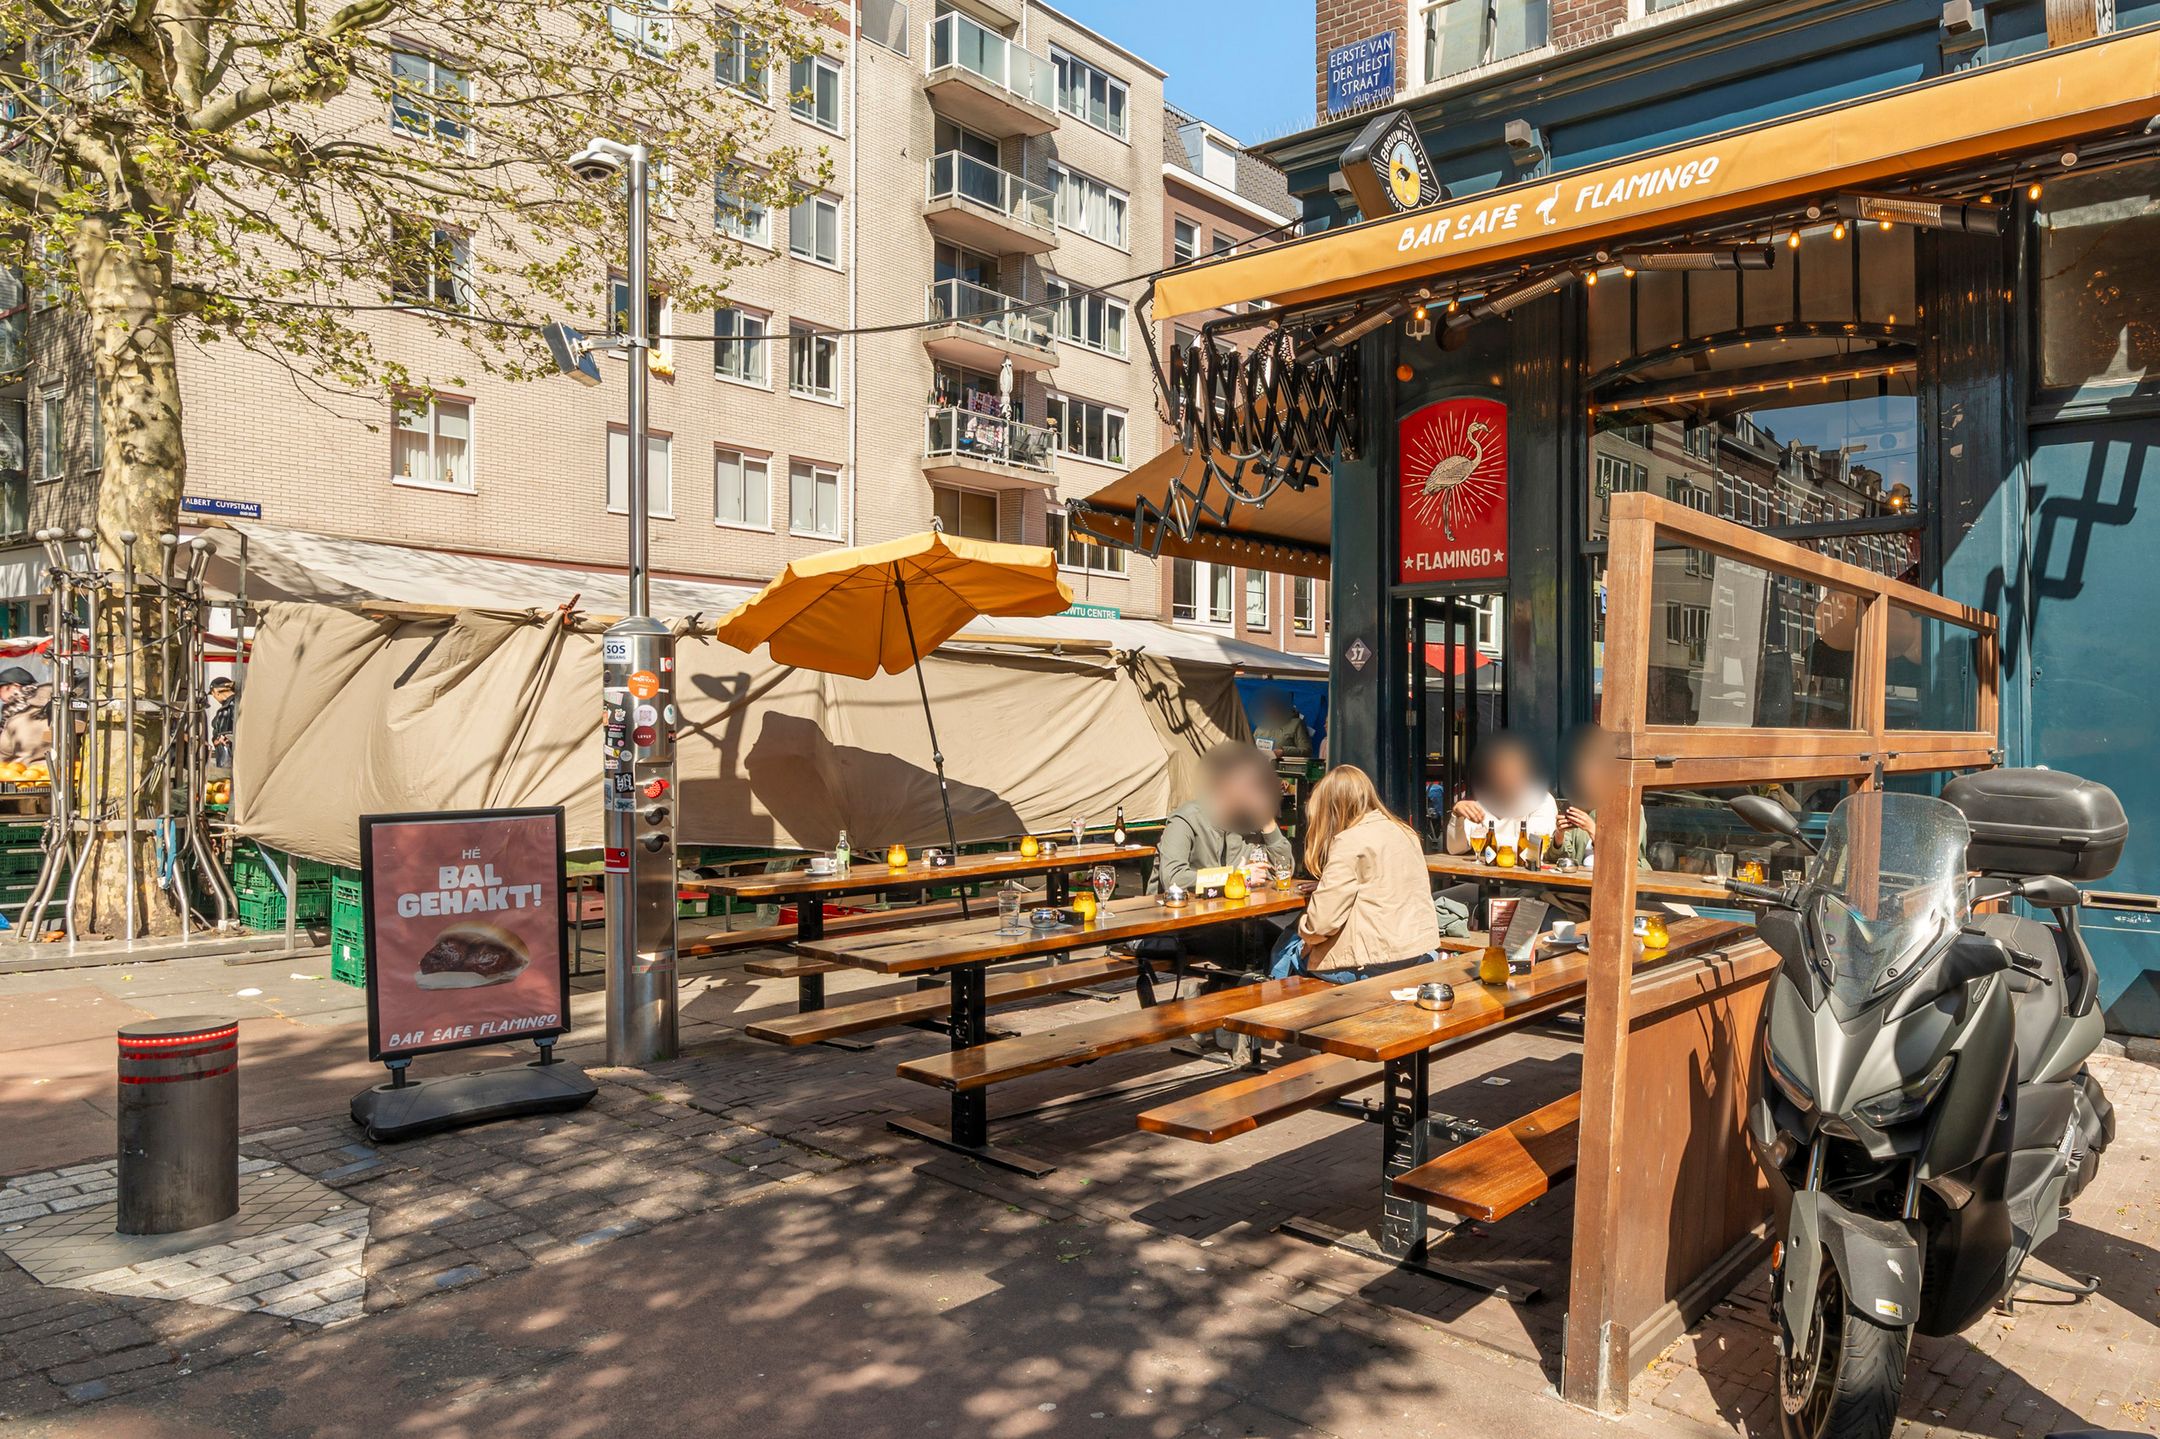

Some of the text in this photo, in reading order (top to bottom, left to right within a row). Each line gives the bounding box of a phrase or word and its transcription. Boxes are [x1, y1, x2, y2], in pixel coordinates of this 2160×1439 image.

[1330, 36, 1392, 68] EERSTE VAN
[1333, 53, 1389, 83] DER HELST
[1341, 72, 1380, 97] STRAAT
[1397, 156, 1720, 252] BAR CAFE FLAMINGO
[185, 497, 258, 512] ALBERT CUYPSTRAAT
[1416, 548, 1491, 571] FLAMINGO
[1086, 608, 1117, 620] CENTRE
[606, 644, 626, 654] SOS
[438, 863, 503, 890] BAL
[397, 883, 542, 918] GEHAKT!
[388, 1014, 557, 1047] BAR CAFE FLAMINGO
